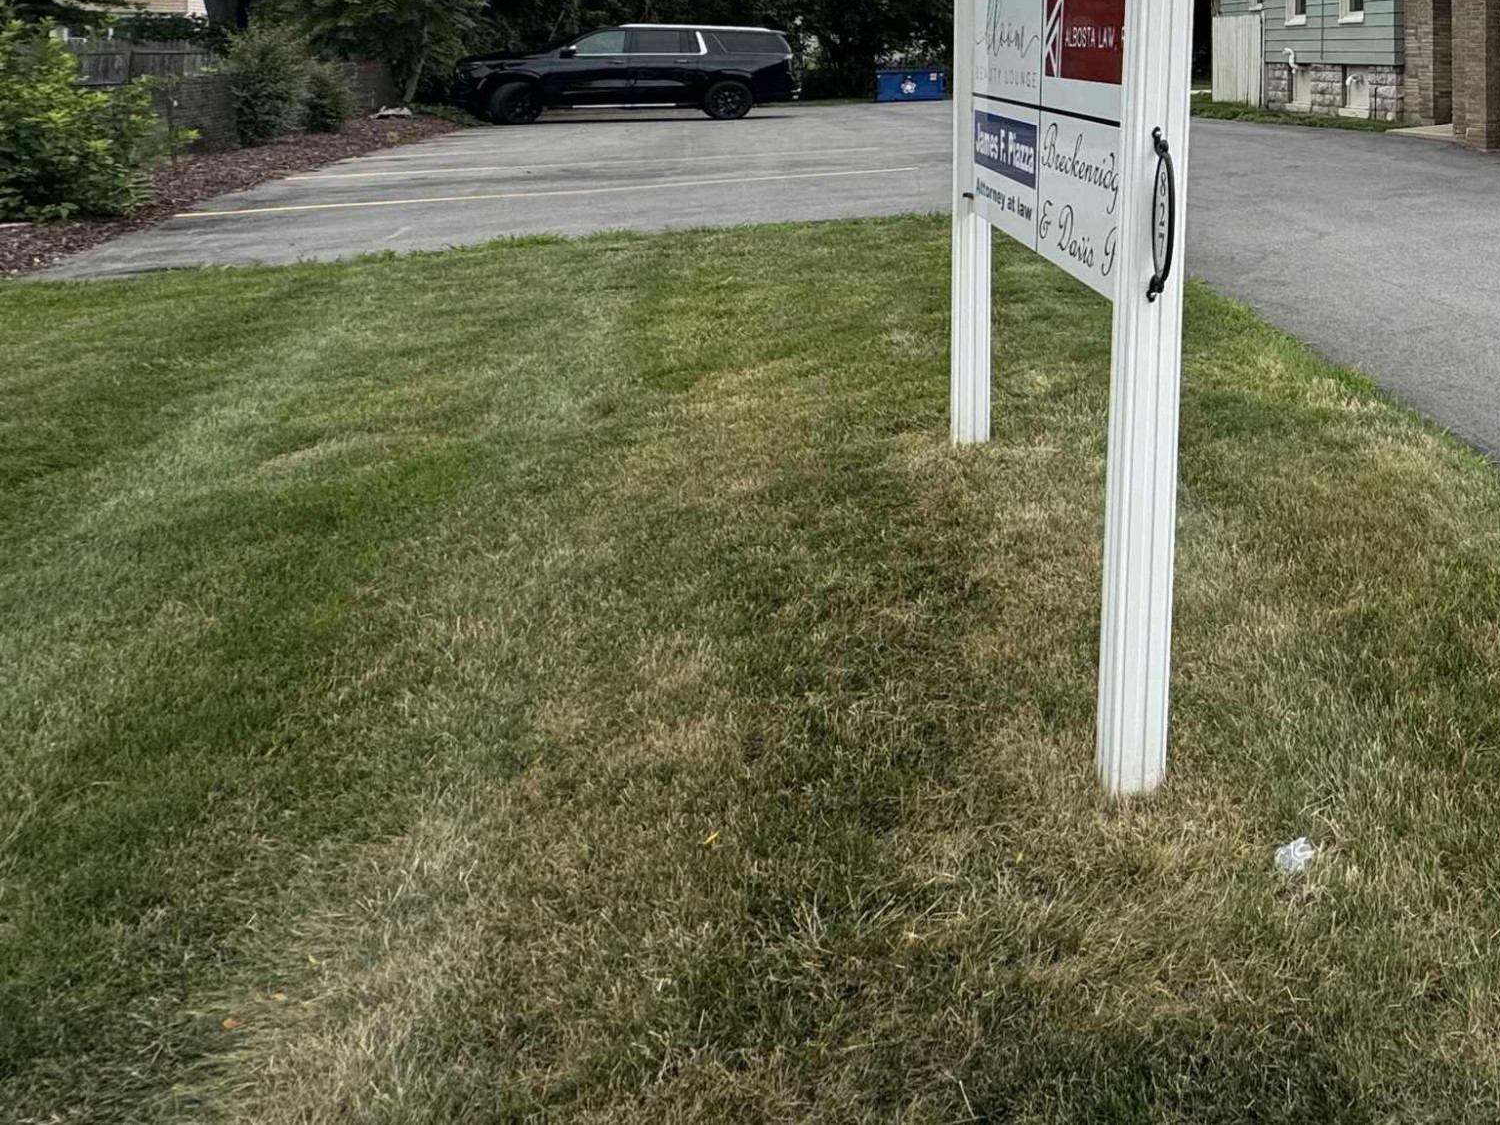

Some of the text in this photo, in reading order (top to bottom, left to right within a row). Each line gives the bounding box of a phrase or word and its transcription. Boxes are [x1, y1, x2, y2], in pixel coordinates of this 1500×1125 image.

[1064, 26, 1096, 48] ALBOSTA
[1004, 69, 1037, 88] LOUNGE
[975, 123, 1035, 174] James F. Piazza
[975, 177, 1033, 222] Attorney at law
[1157, 172, 1167, 258] 827
[1039, 200, 1053, 239] &
[1057, 204, 1094, 268] Davis
